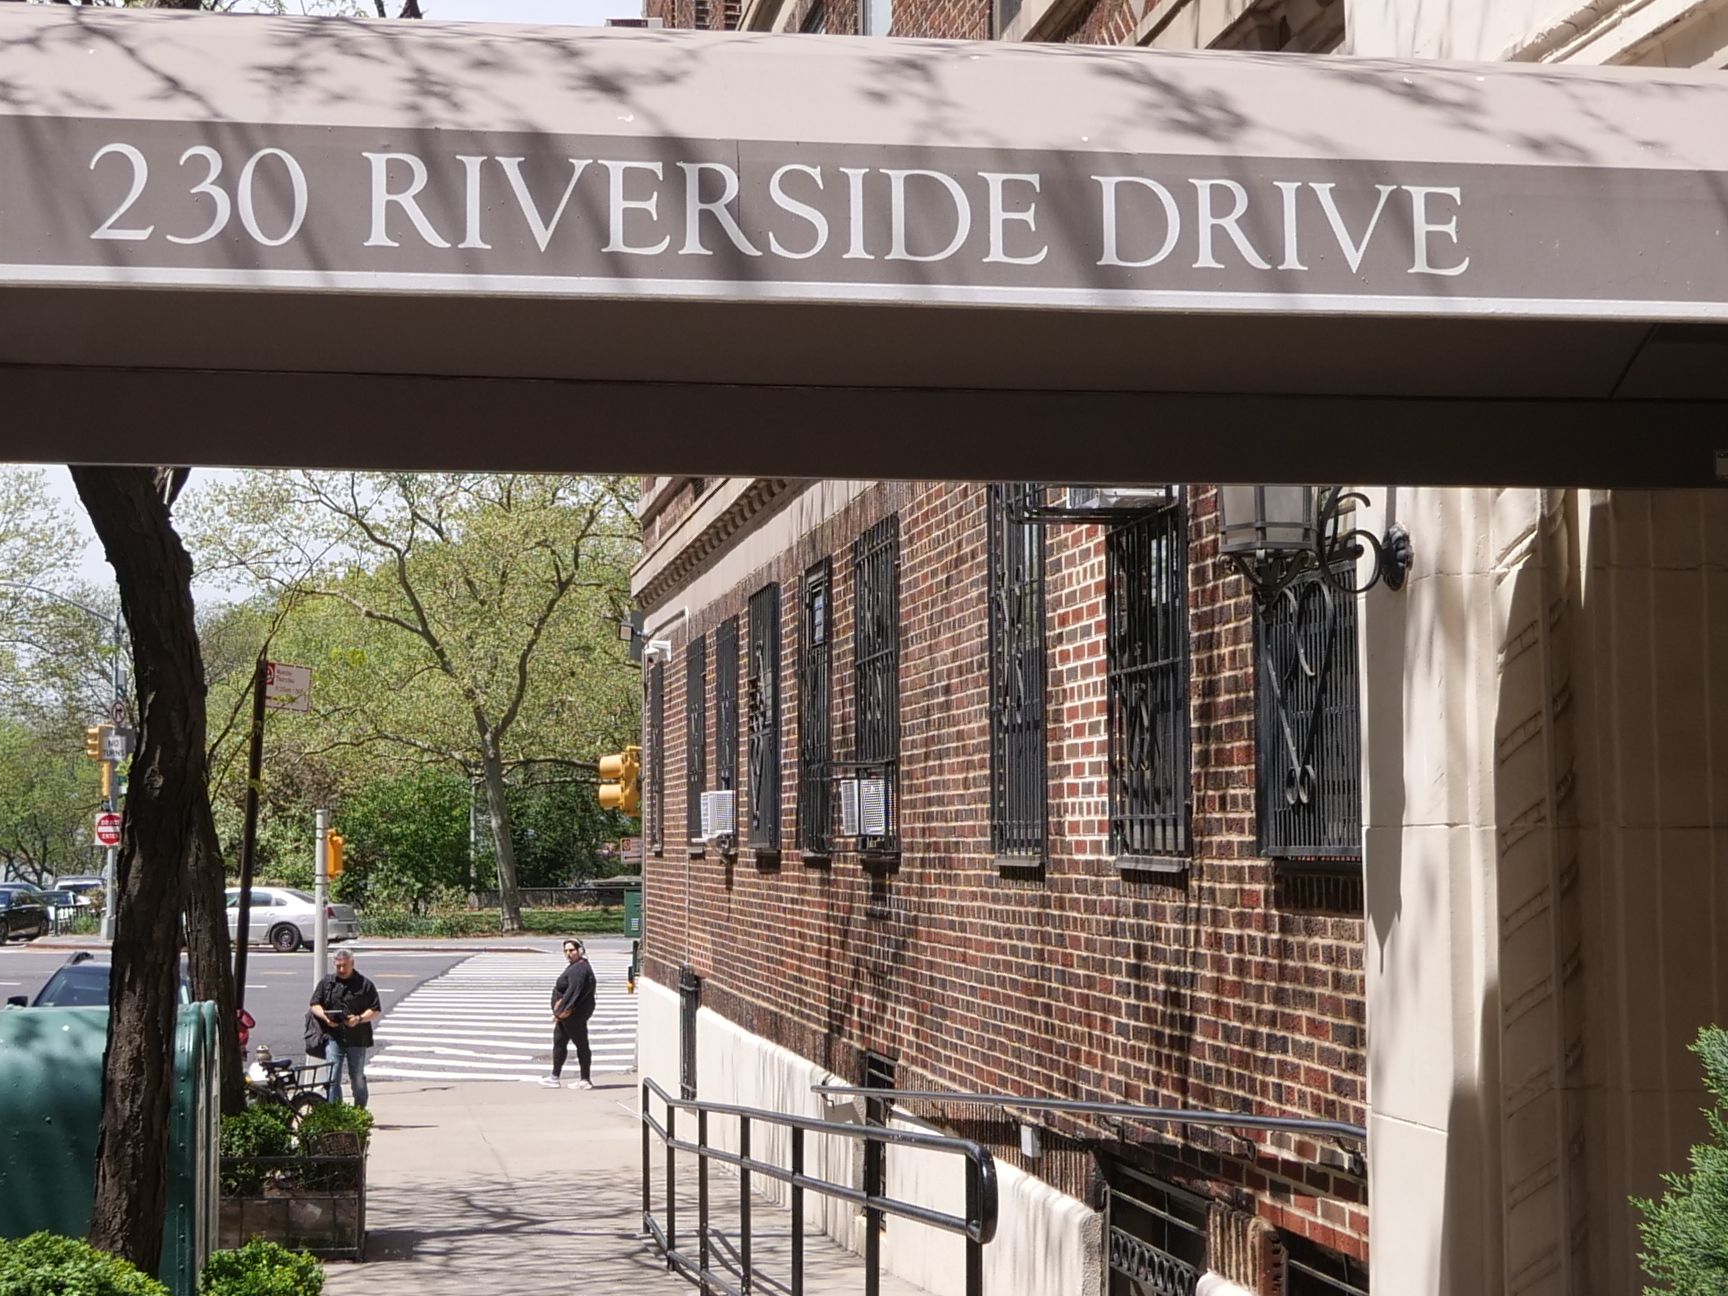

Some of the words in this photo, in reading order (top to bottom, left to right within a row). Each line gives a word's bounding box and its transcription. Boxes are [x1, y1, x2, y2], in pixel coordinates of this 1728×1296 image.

[90, 143, 307, 246] 230
[362, 150, 1048, 264] RIVERSIDE
[1091, 176, 1469, 275] DRIVE
[108, 739, 120, 747] NO
[102, 749, 124, 757] TURNS
